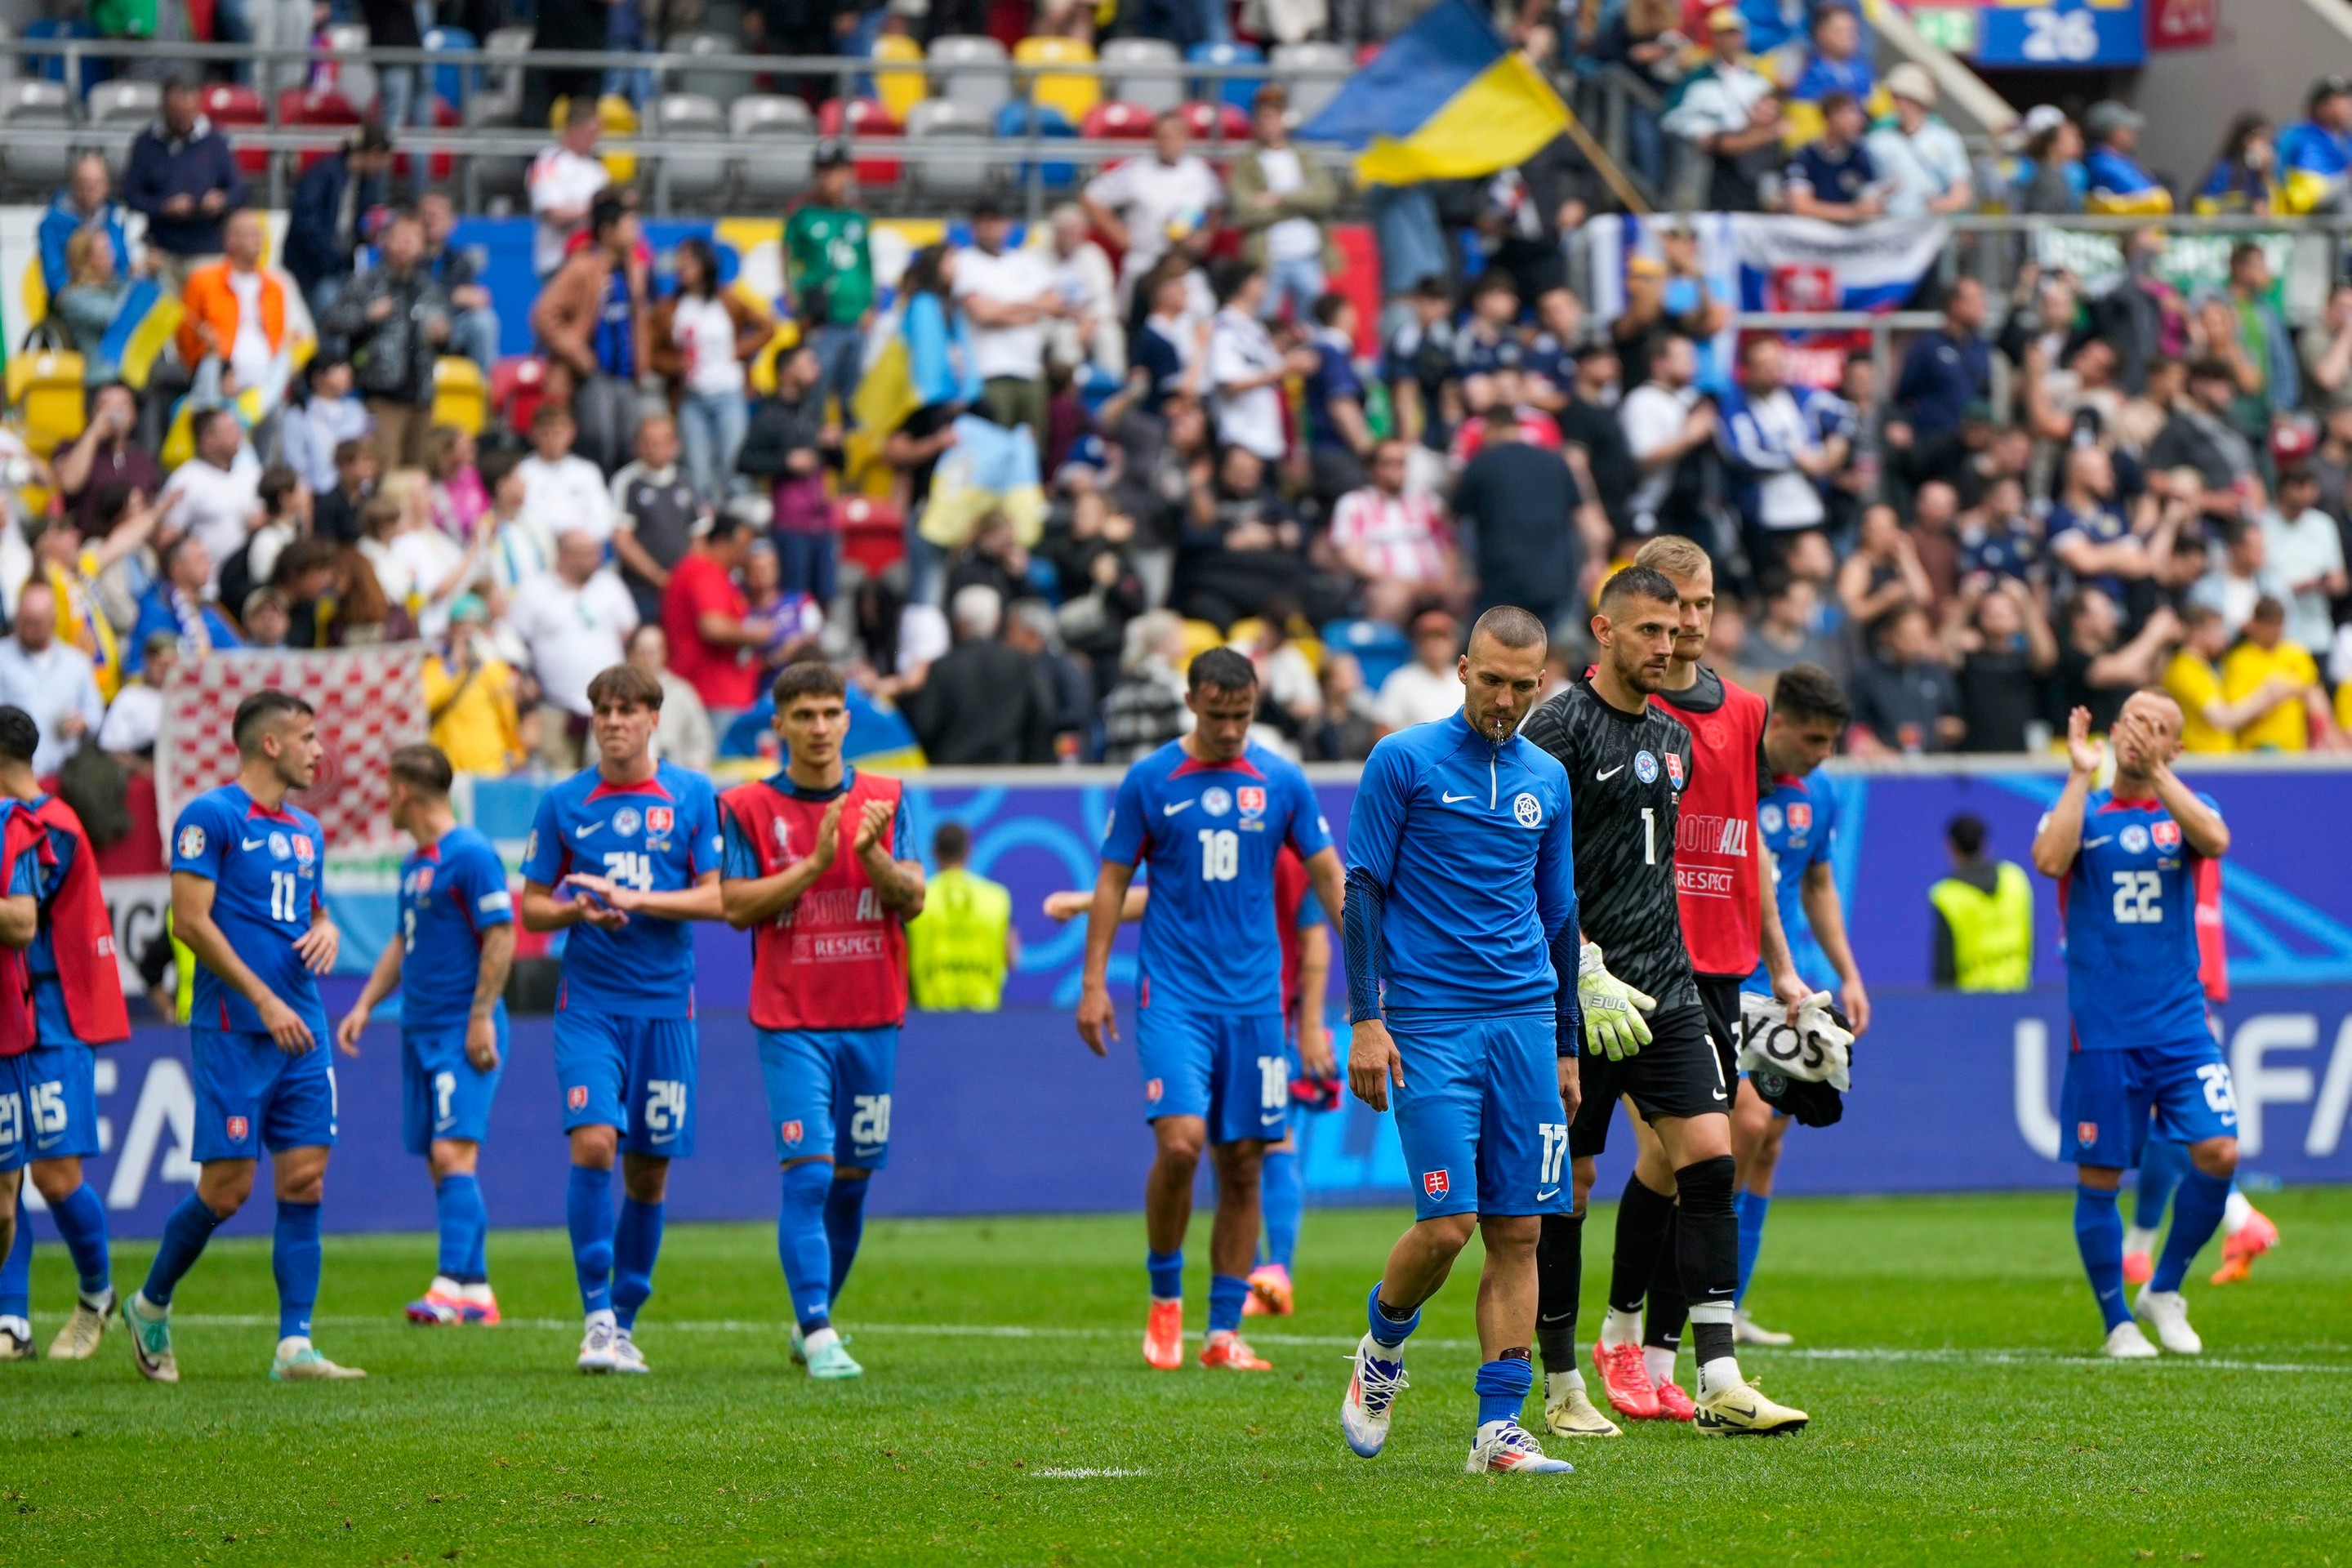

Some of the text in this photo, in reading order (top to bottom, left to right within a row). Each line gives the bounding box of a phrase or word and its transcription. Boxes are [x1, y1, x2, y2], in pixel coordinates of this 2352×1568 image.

[2023, 9, 2099, 60] 26
[1198, 829, 1238, 881] 18
[1642, 808, 1655, 865] 1
[270, 871, 296, 923] 11
[604, 851, 654, 893] 24
[1677, 871, 1733, 892] RESPECT
[2113, 871, 2163, 923] 22
[814, 936, 882, 956] RESPECT
[1258, 1055, 1288, 1108] 18
[1704, 1034, 1726, 1088] 1
[0, 1091, 22, 1143] 21
[29, 1080, 67, 1134] 15
[645, 1080, 686, 1131] 24
[851, 1094, 891, 1143] 20
[1539, 1123, 1568, 1183] 17
